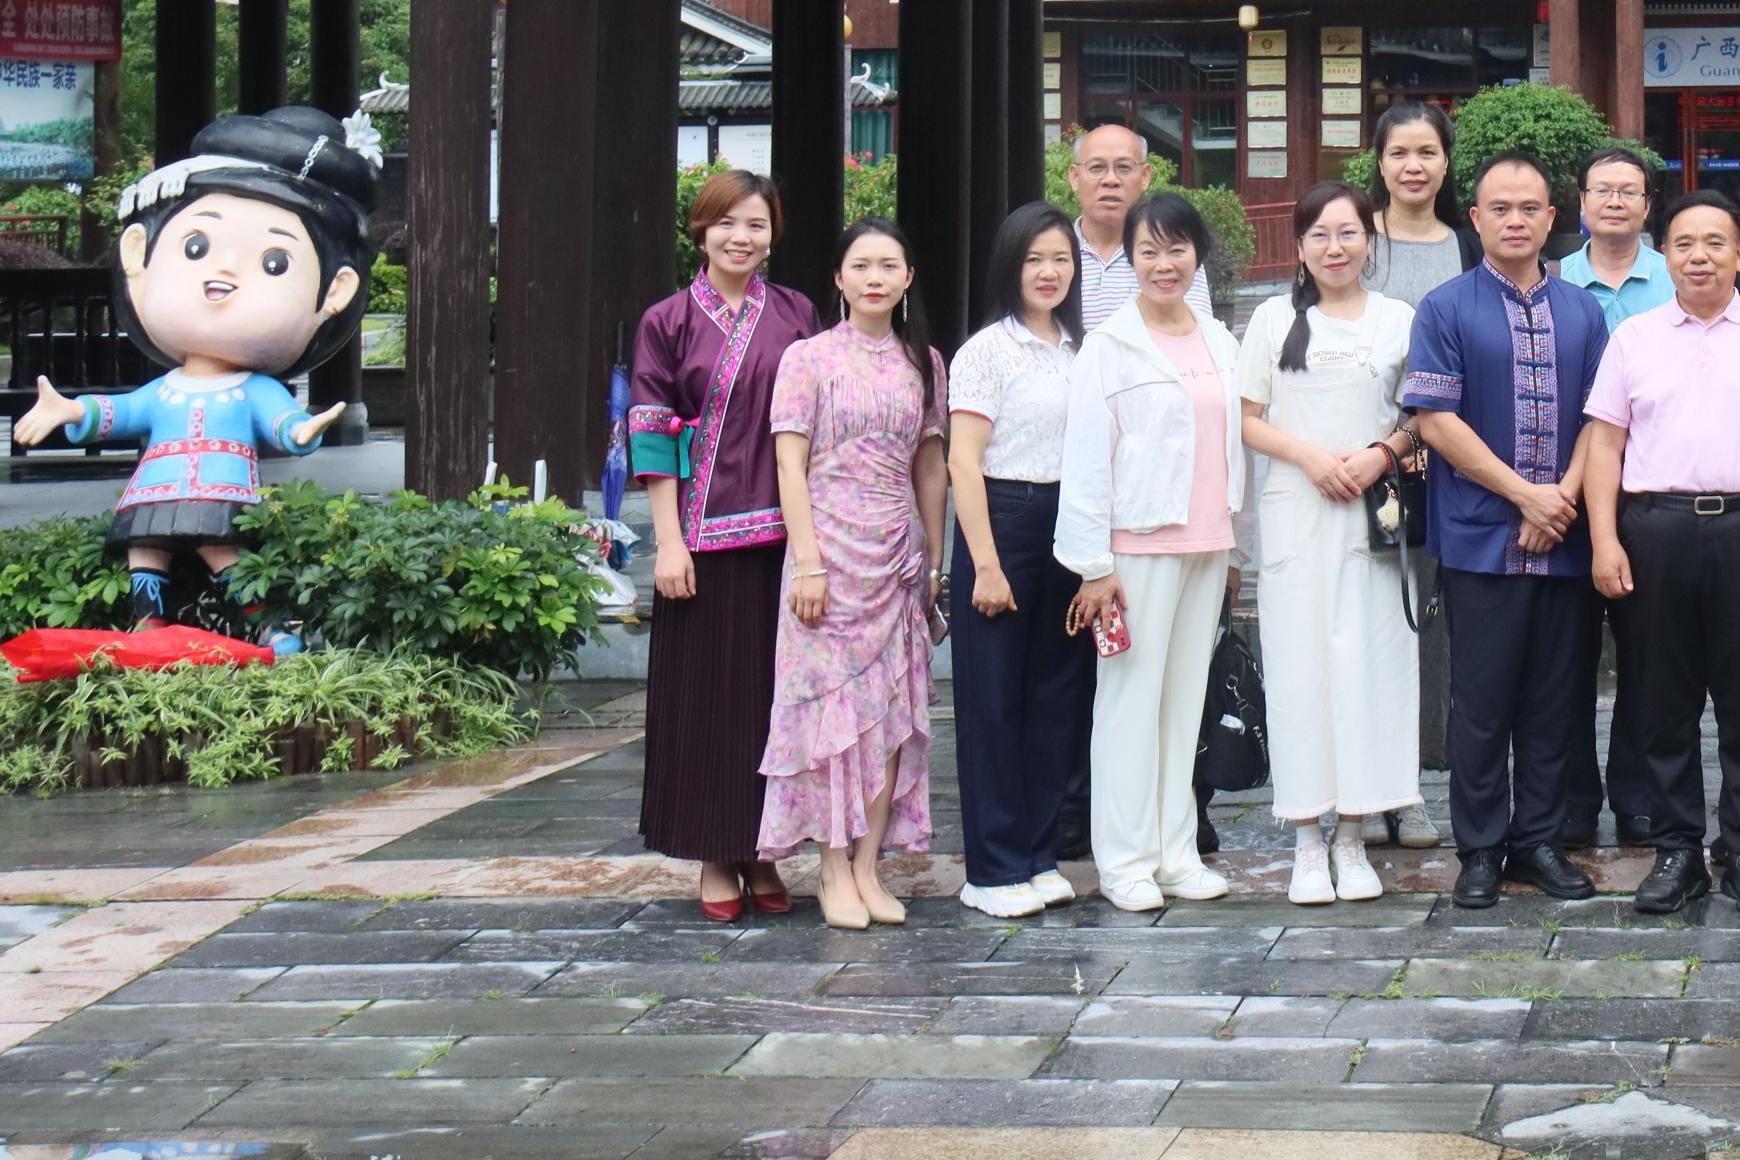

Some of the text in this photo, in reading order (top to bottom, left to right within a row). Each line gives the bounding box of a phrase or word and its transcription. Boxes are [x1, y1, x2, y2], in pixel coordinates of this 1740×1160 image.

[0, 59, 77, 91] 华民族一家亲
